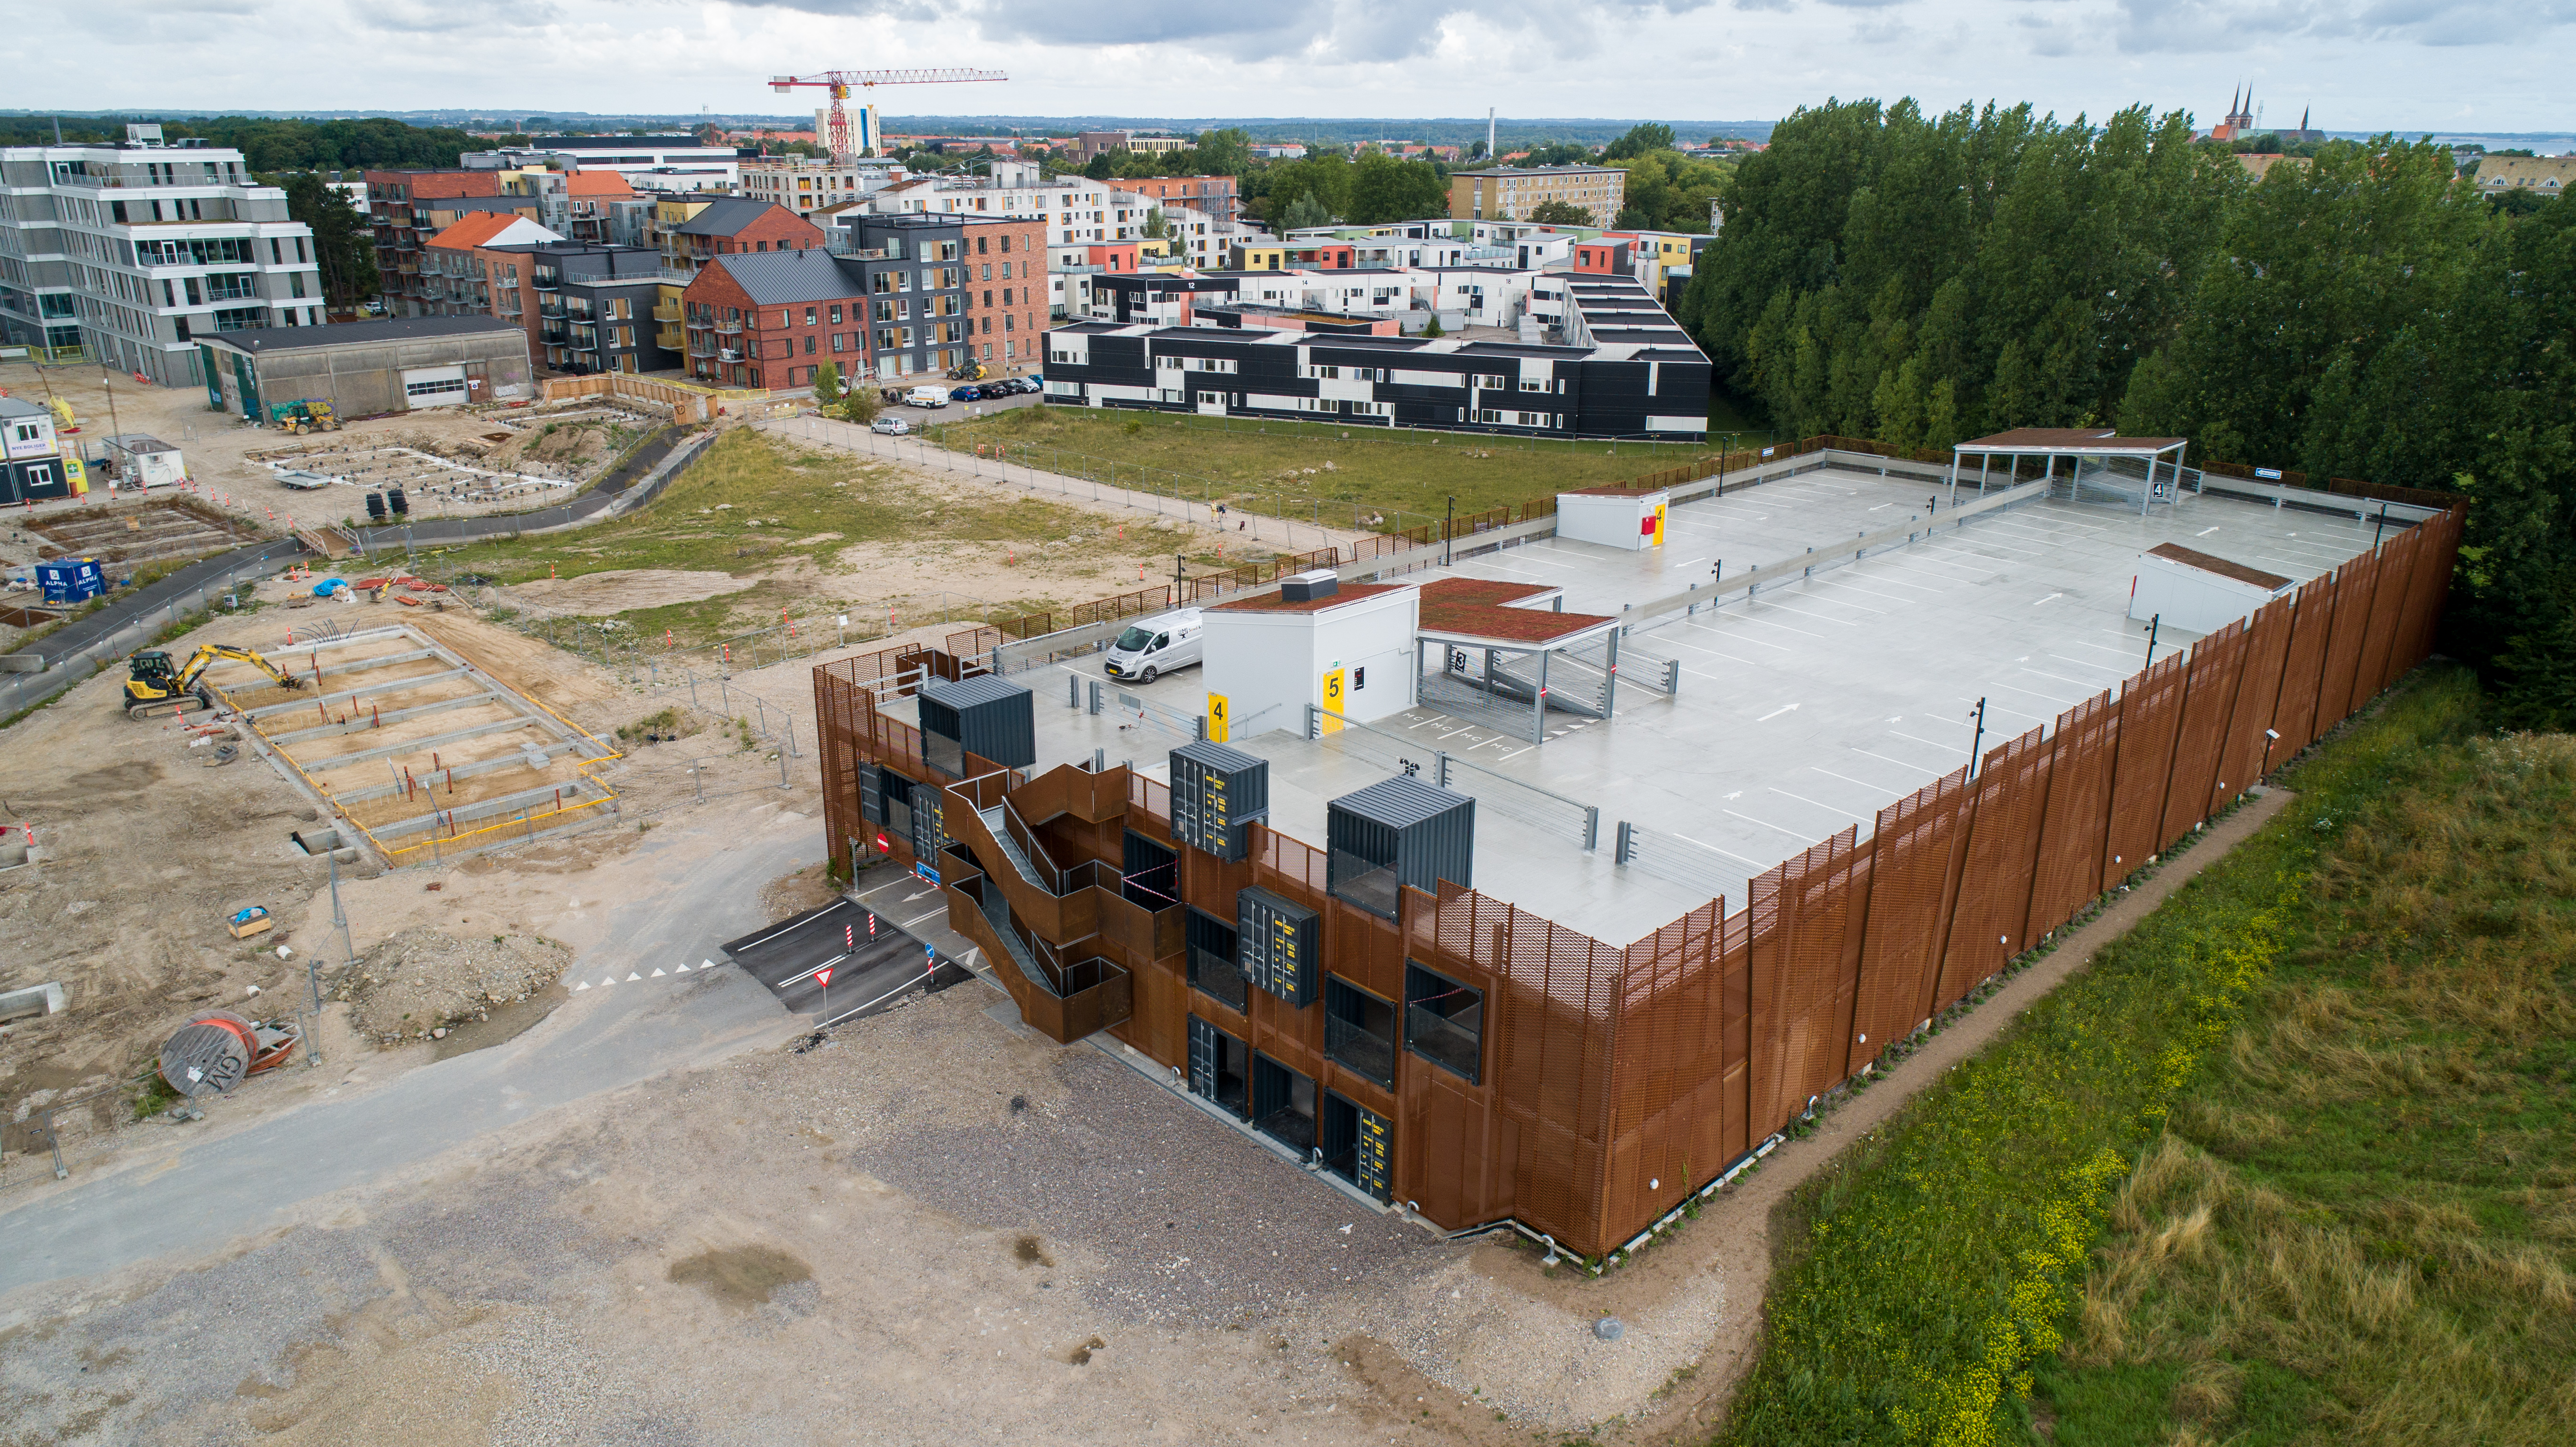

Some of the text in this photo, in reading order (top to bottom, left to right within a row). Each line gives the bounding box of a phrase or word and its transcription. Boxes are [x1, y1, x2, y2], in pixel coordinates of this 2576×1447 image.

[2155, 484, 2162, 494] 4
[1657, 509, 1662, 522] 4
[1457, 654, 1464, 667] 3
[1329, 677, 1339, 698] 5
[1214, 702, 1223, 720] 4
[1403, 713, 1424, 721] MC
[1431, 723, 1453, 731] MC
[1460, 732, 1482, 741] MC
[1490, 743, 1513, 752] MC
